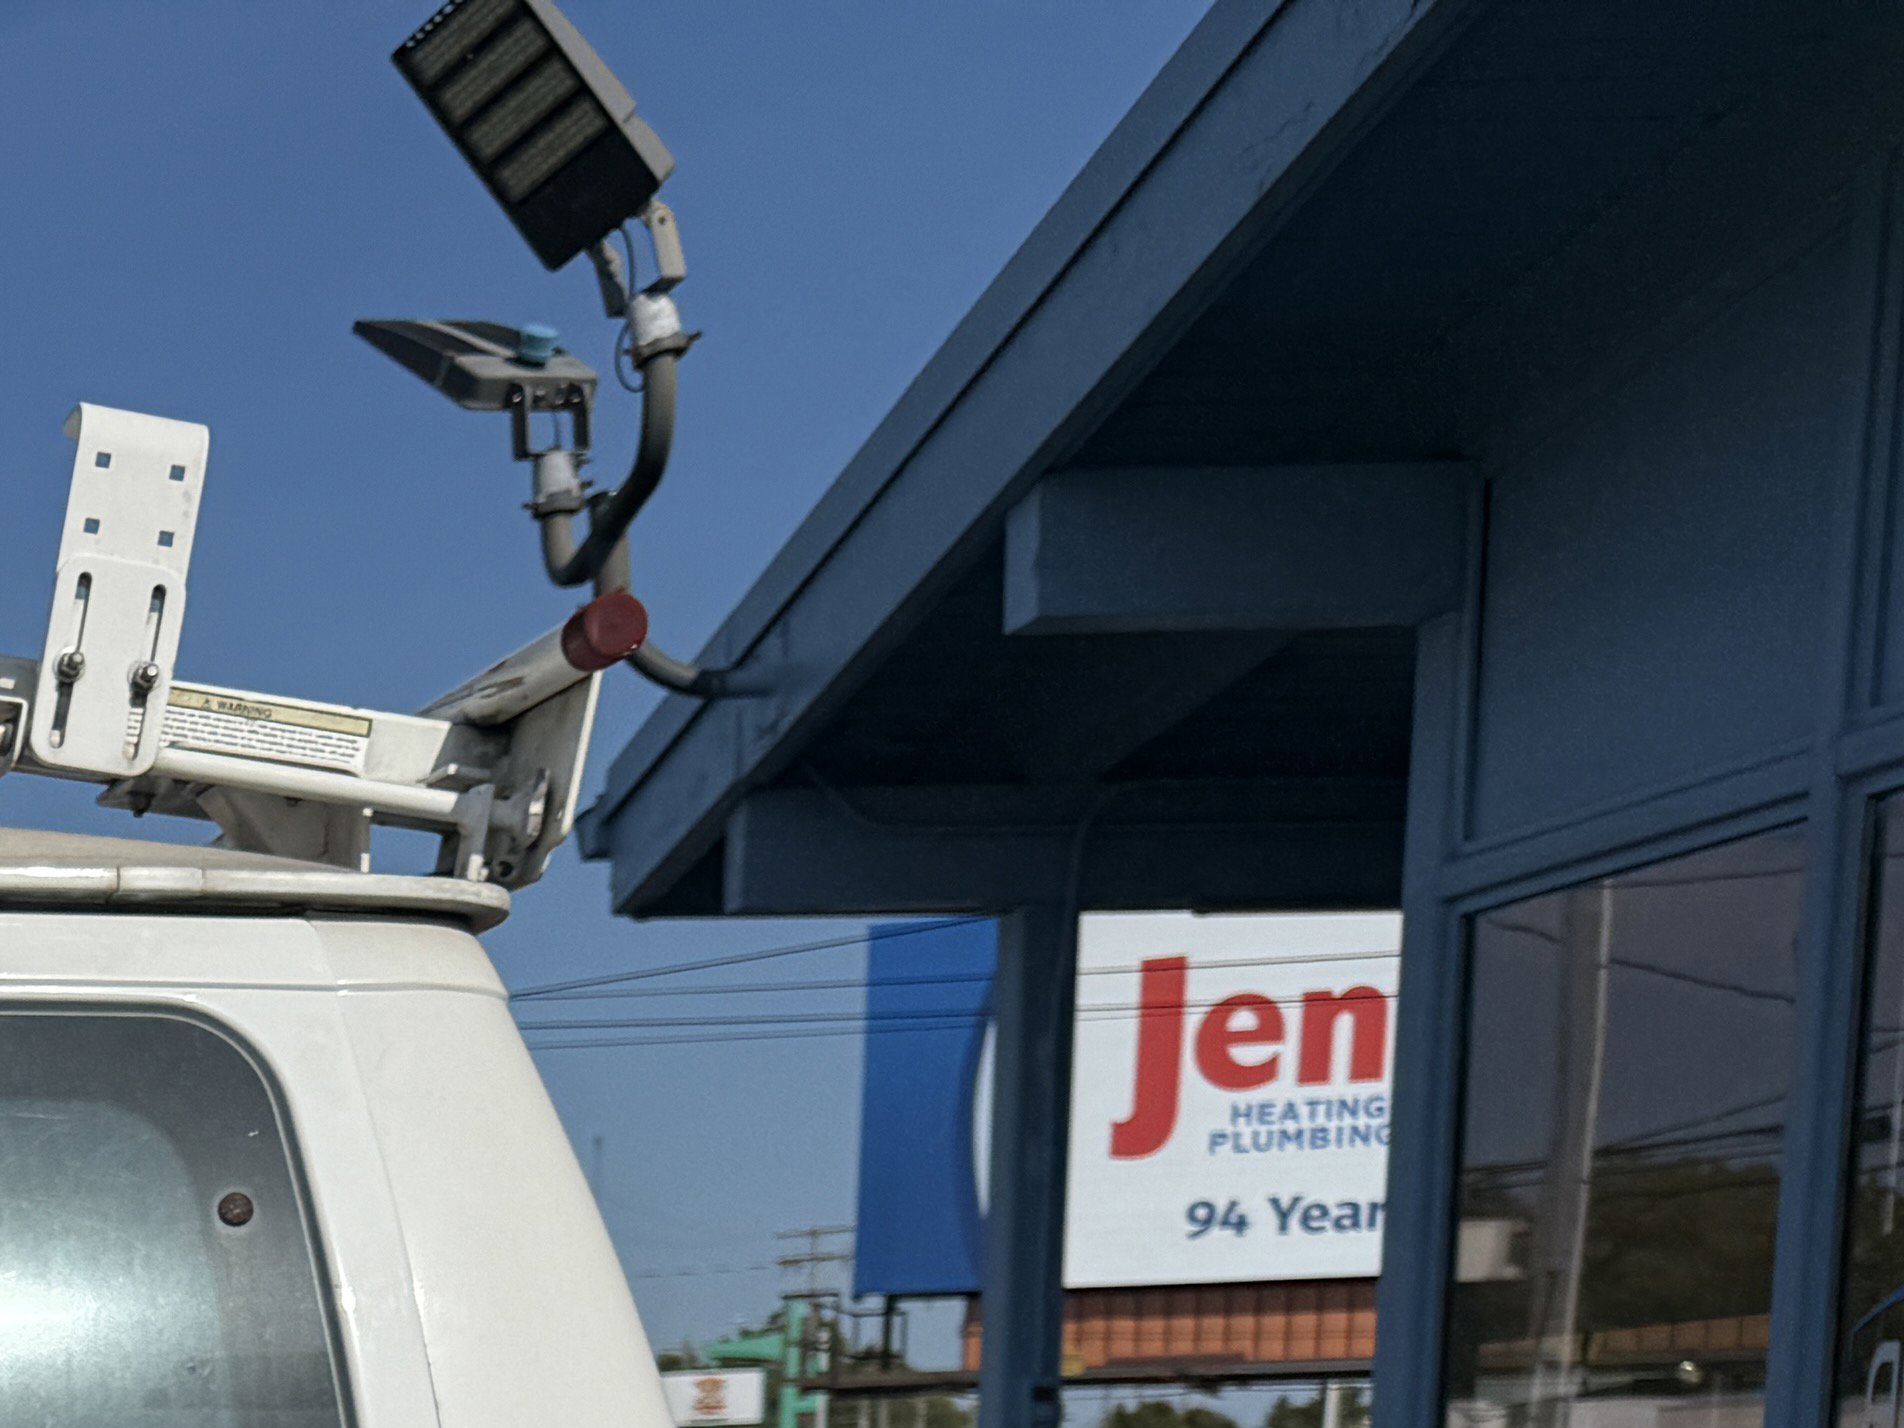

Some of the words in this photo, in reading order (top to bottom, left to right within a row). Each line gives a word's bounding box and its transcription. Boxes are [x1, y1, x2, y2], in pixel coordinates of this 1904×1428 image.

[216, 700, 273, 719] WARNING
[1109, 955, 1389, 1161] Jen
[1229, 1096, 1388, 1127] HEATING
[1207, 1124, 1391, 1155] PLUMBING
[1185, 1199, 1249, 1239] 94
[1267, 1195, 1387, 1235] Year
